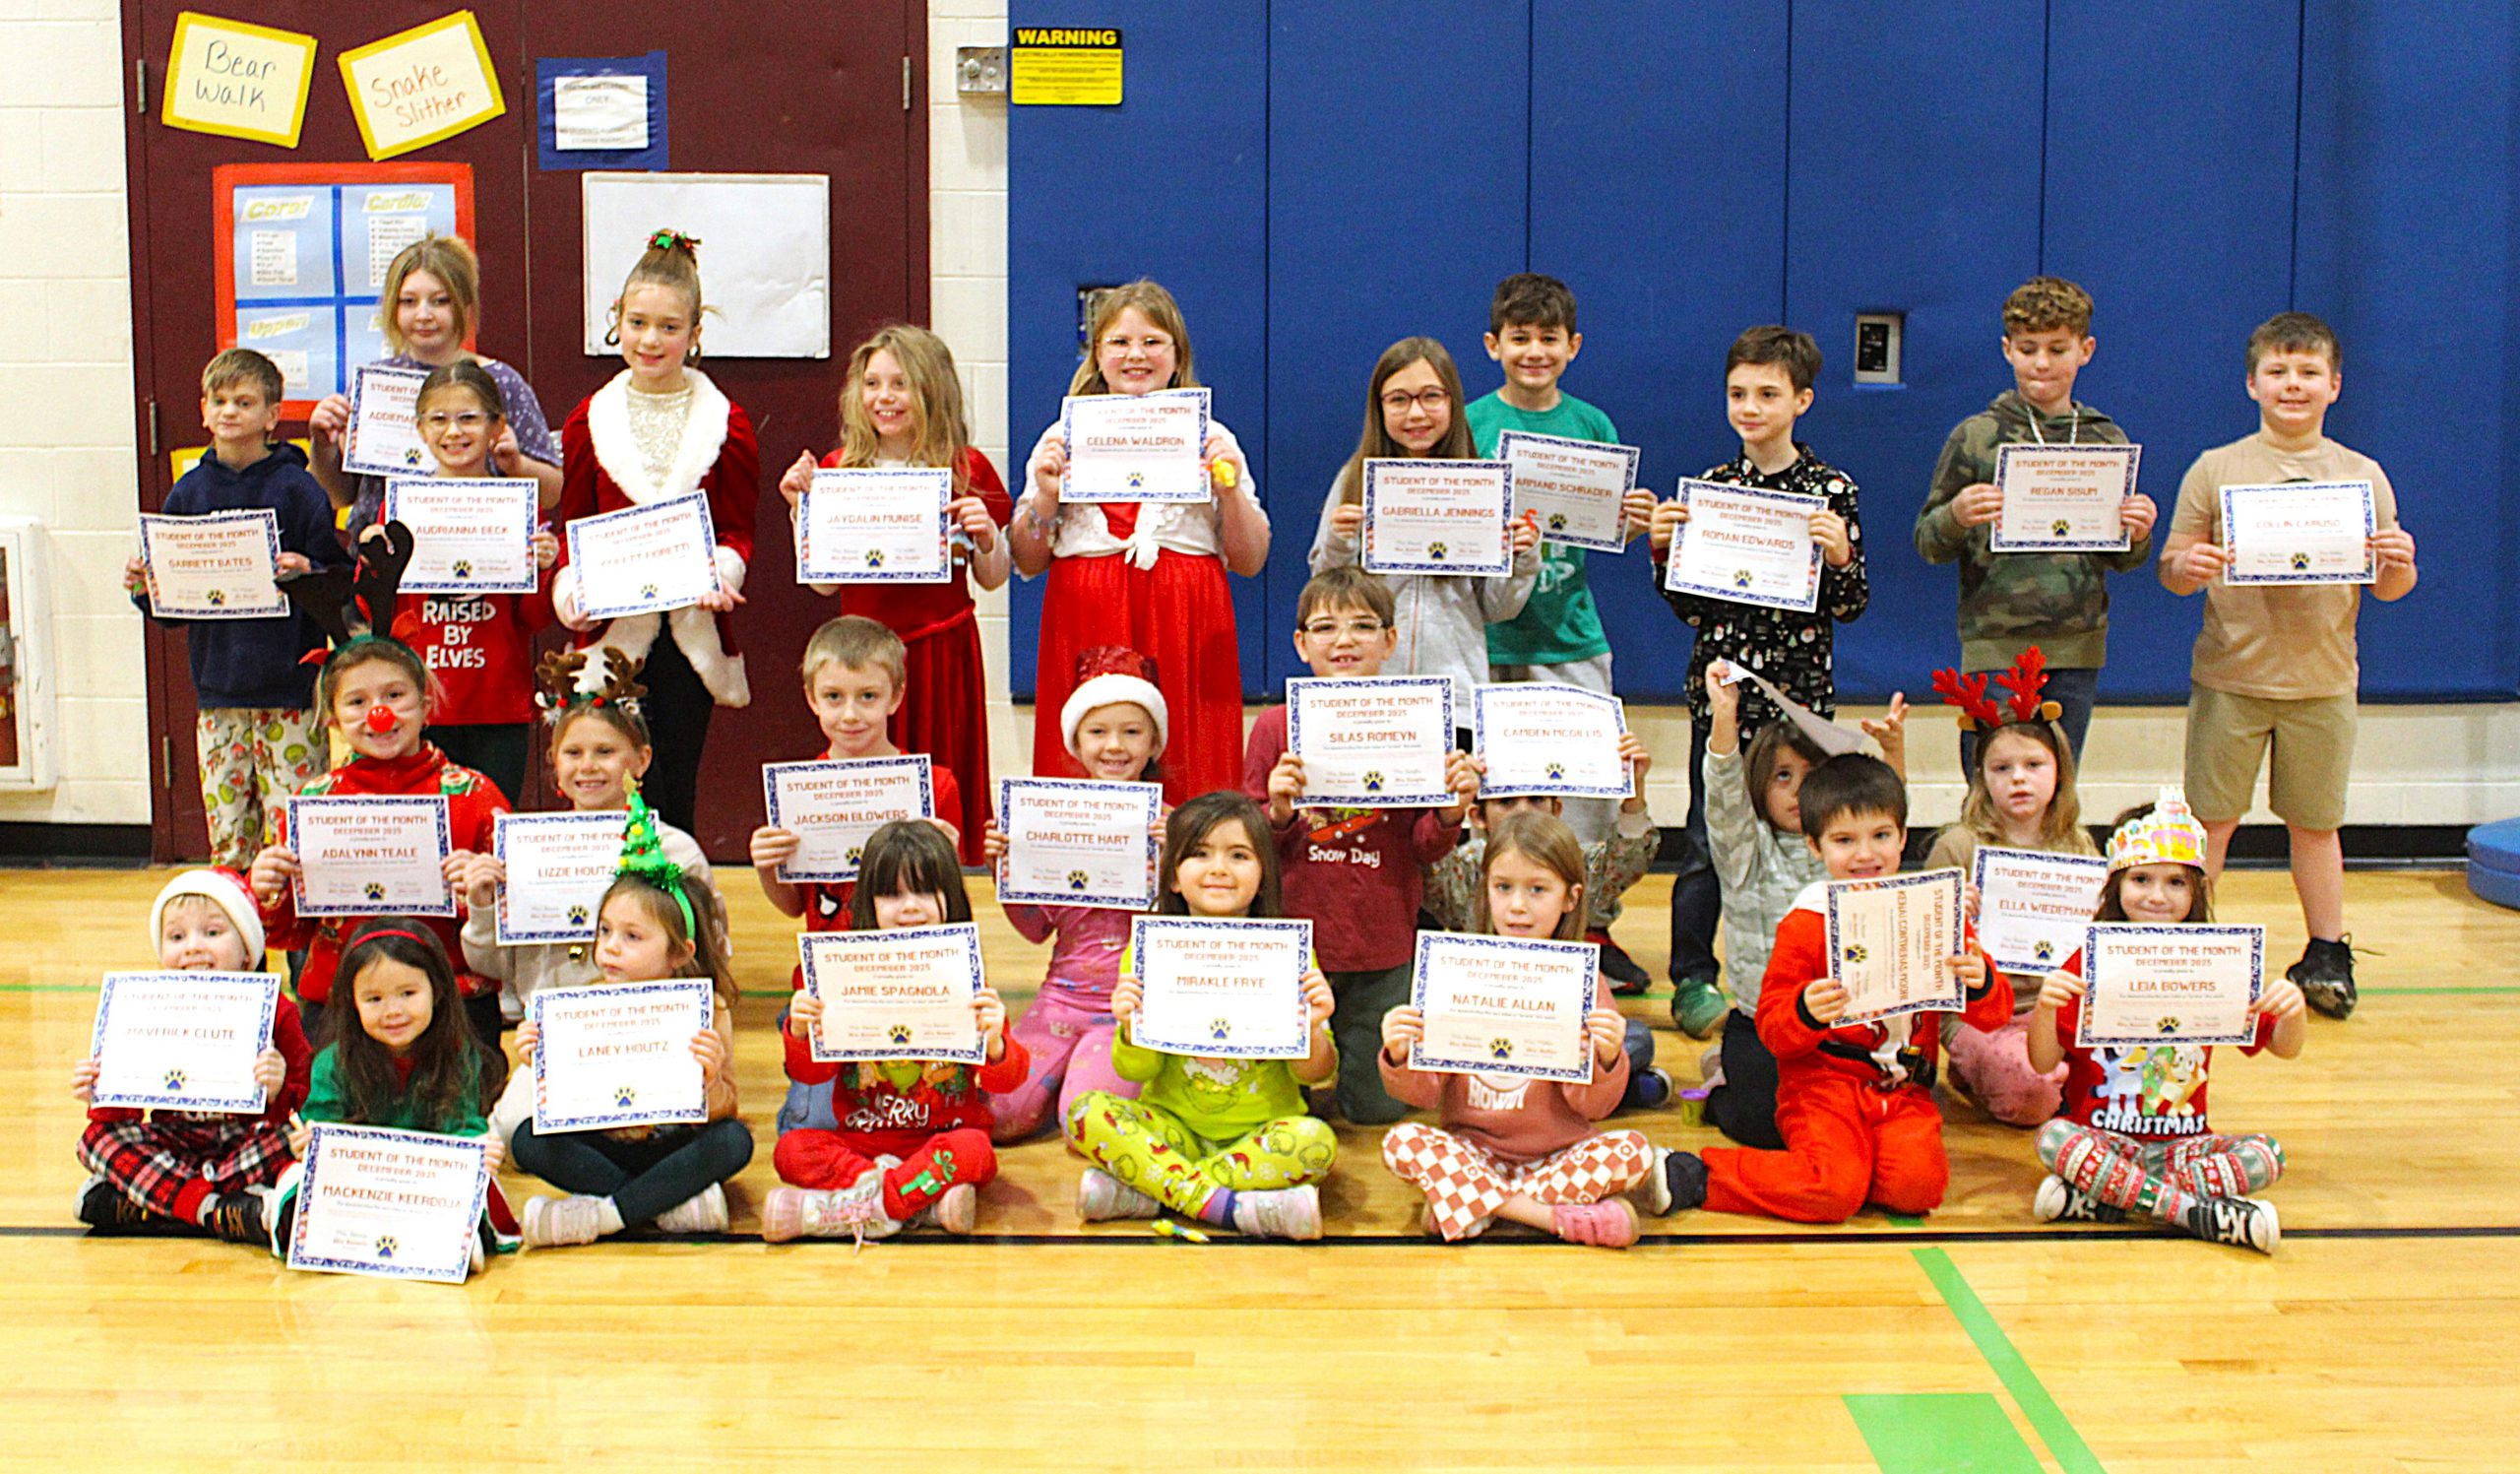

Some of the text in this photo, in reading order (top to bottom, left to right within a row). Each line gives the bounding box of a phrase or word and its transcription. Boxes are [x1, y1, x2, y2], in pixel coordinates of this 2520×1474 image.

[1017, 30, 1116, 45] WARNING
[205, 40, 277, 81] Bear
[371, 65, 449, 108] Snake
[396, 92, 466, 129] Slither
[367, 193, 429, 211] Cardio:
[370, 383, 408, 393] STUDENT
[1088, 437, 1127, 446] CELENA
[1516, 450, 1555, 461] STUDENT
[1572, 457, 1586, 466] THE
[1589, 459, 1619, 470] MONTH
[1384, 477, 1426, 485] STUDENT
[1515, 478, 1556, 491] ARMAND
[1559, 483, 1612, 498] SCHRADER
[1382, 507, 1495, 518] GABRIELLA JENNINGS
[1697, 499, 1739, 511] STUDENT
[1756, 506, 1771, 515] THE
[415, 526, 509, 535] AUDRIANNA BECK
[1702, 530, 1739, 543] ROMAN
[1742, 535, 1796, 550] EDWARDS
[168, 557, 252, 568] GARRETT BATES
[422, 601, 496, 625] RAISED
[444, 624, 472, 645] BY
[425, 645, 485, 670] ELVES
[1310, 697, 1434, 708] STUDENT OF THE MONTH
[1329, 732, 1417, 743] SILAS ROMEYN
[1503, 729, 1550, 737] CAMDEN
[788, 776, 910, 792] STUDENT OF THE MONTH
[1020, 798, 1138, 811] STUDENT OF THE MONTH
[308, 815, 353, 825] STUDENT
[356, 816, 368, 825] OF
[794, 809, 909, 825] JACKSON BLOWERS
[516, 834, 562, 844] STUDENT
[1026, 831, 1130, 845] CHARLOTTE HART
[322, 847, 417, 859] ADALYNN TEALE
[1308, 845, 1381, 867] Snow Day
[538, 866, 571, 878] LIZZIE
[1994, 867, 2038, 879] STUDENT
[2055, 873, 2072, 882] THE
[1999, 900, 2026, 911] ELLA
[1157, 938, 1289, 950] STUDENT OF THE MONTH
[2108, 946, 2241, 956] STUDENT OF THE MONTH
[824, 948, 959, 963] STUDENT OF THE MONTH
[1440, 956, 1574, 974] STUDENT OF THE MONTH
[1176, 976, 1266, 989] MIRAKLE FRYE
[2129, 982, 2217, 993] LEIA BOWERS
[841, 986, 950, 996] JAMIE SPAGNOLA
[1452, 993, 1556, 1012] NATALIE ALLAN
[555, 1002, 689, 1021] STUDENT OF THE MONTH
[194, 1028, 235, 1040] CLUTE
[579, 1041, 668, 1058] LANEY HOUTZ
[1468, 1075, 1531, 1111] HOWDY
[2091, 1109, 2206, 1134] CHRISTMAS
[330, 1148, 469, 1171] STUDENT OF THE MONTH
[323, 1185, 394, 1202] MACKENZIE
